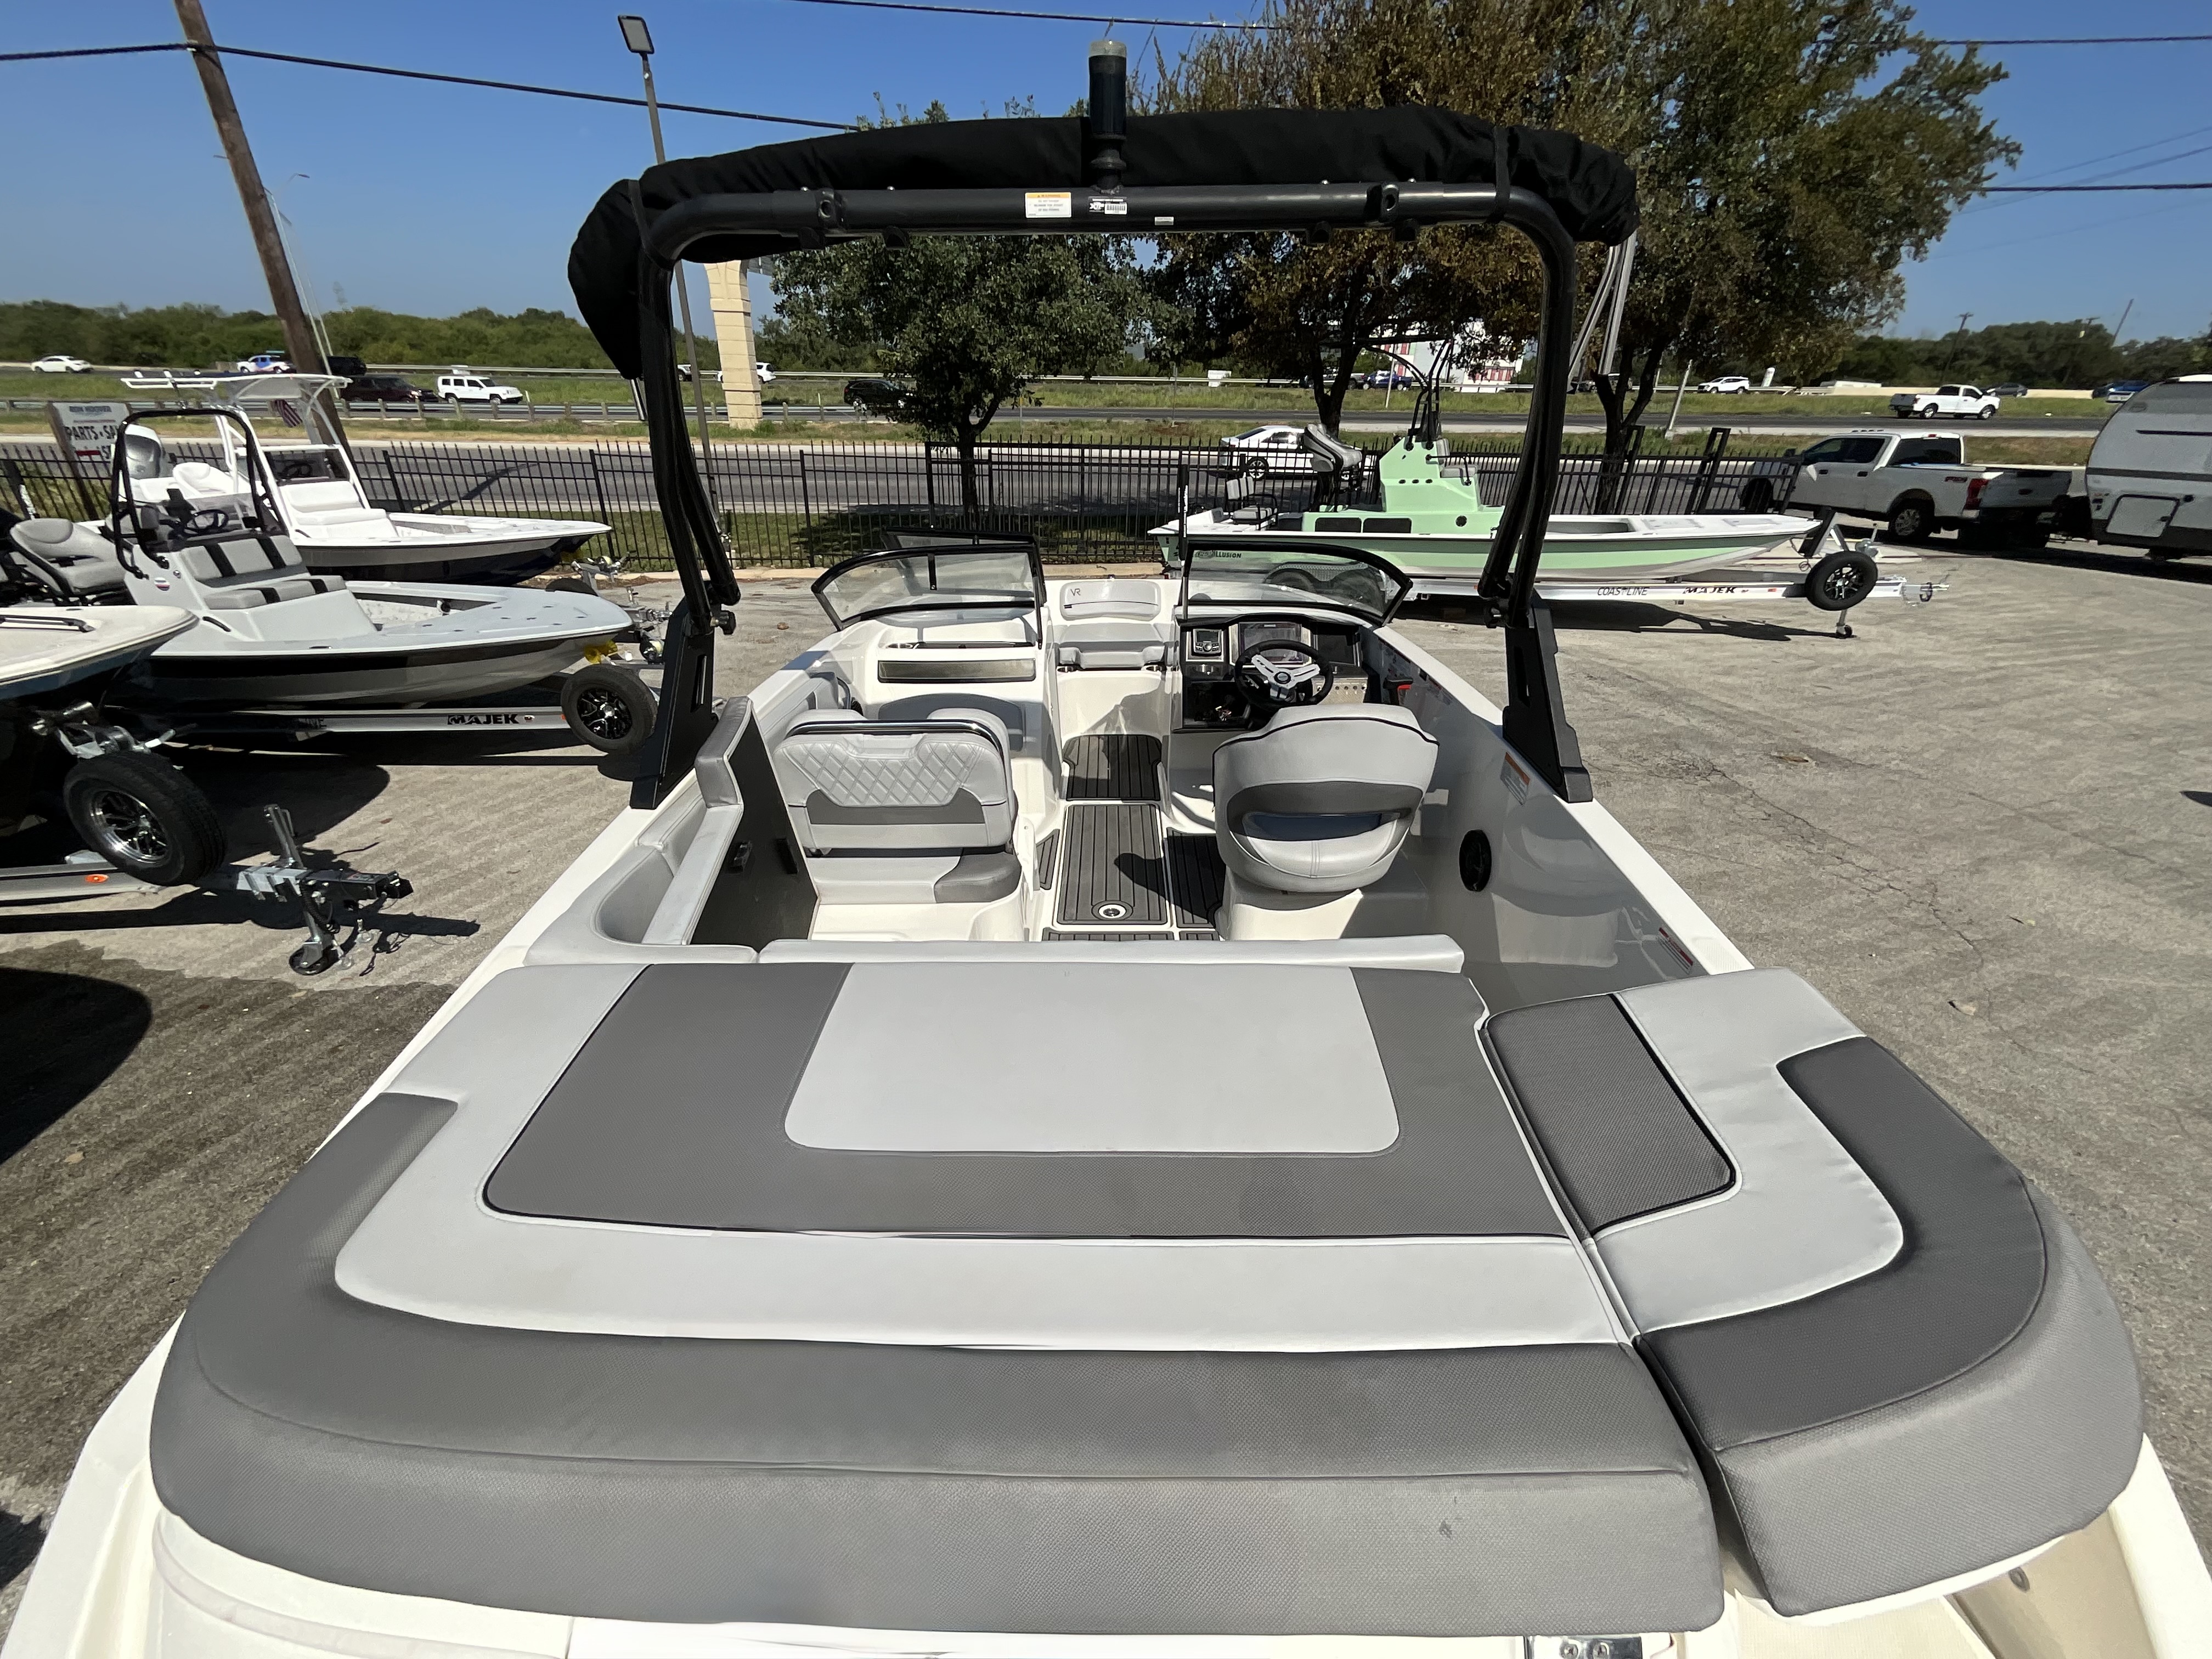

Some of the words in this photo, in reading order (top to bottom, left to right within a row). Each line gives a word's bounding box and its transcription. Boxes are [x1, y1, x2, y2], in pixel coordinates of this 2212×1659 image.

[64, 426, 99, 440] PARTS
[1070, 588, 1081, 596] VR
[1597, 587, 1649, 596] COASTLINE
[447, 713, 520, 725] MAJEK
